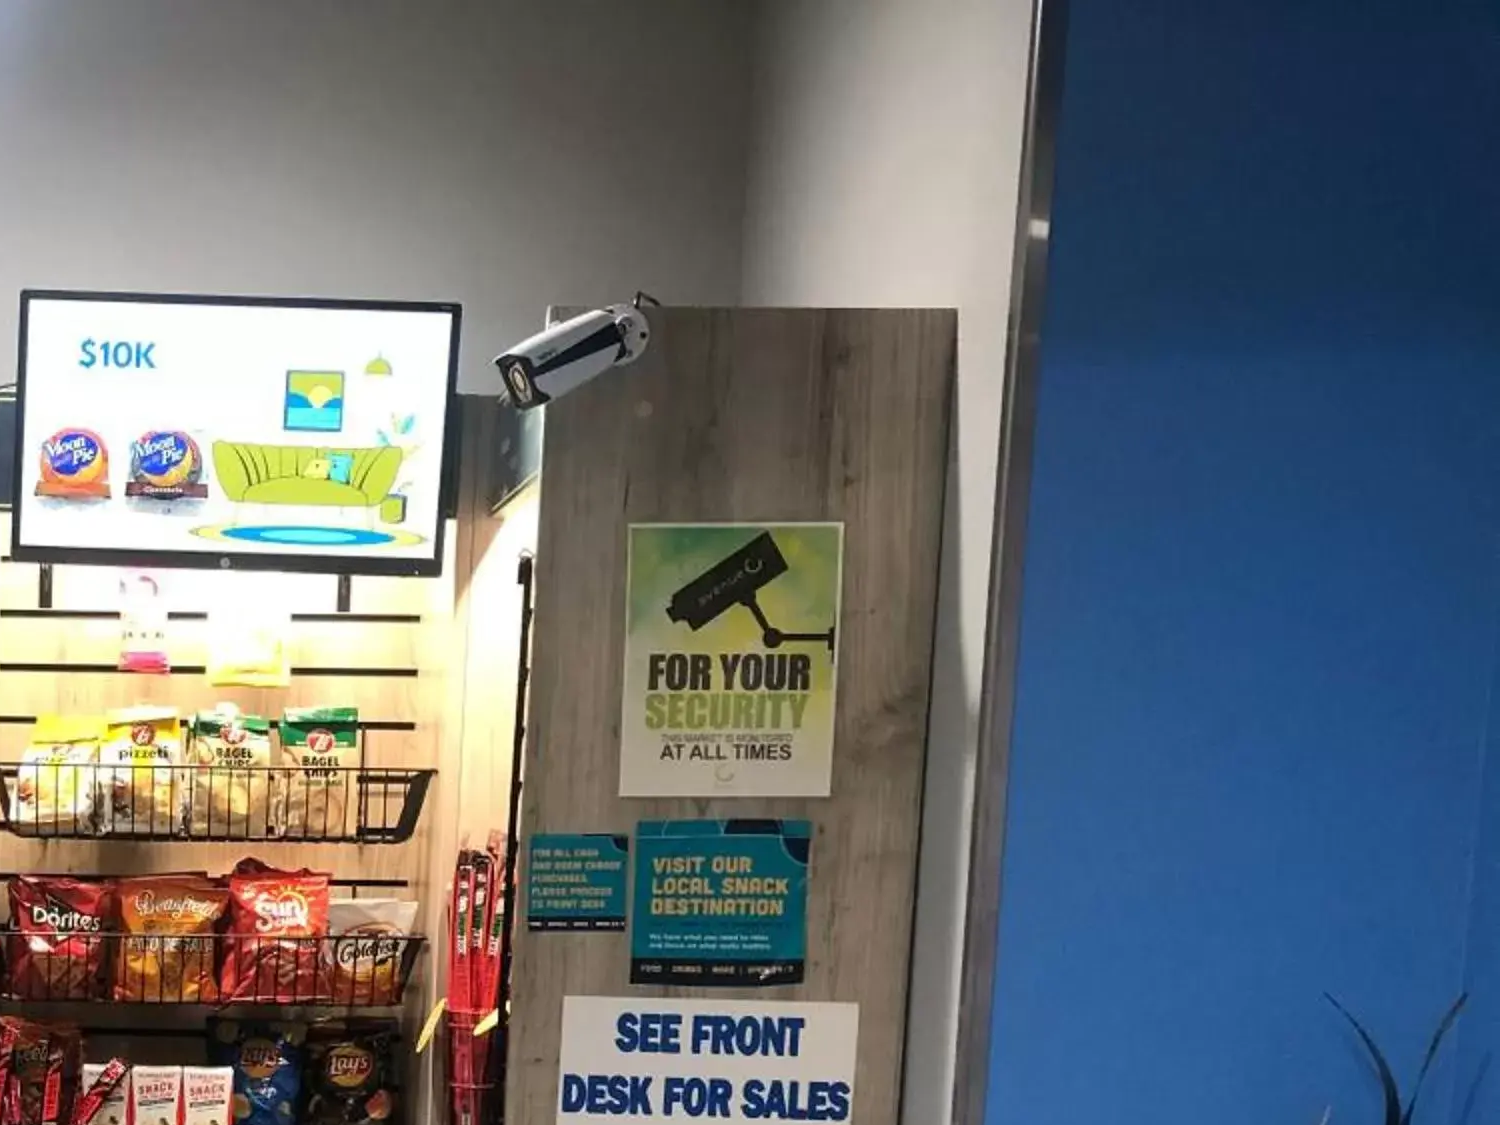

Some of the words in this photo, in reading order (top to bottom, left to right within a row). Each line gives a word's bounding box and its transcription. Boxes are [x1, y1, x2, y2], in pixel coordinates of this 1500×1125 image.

[78, 338, 155, 369] $10K
[45, 437, 86, 456] Moon
[73, 449, 95, 465] Pie
[648, 654, 711, 690] FOR
[720, 654, 810, 690] YOUR
[645, 693, 810, 730] SECURITY
[216, 748, 252, 759] BAGEL
[302, 756, 339, 767] BAGEL
[660, 744, 686, 760] AT
[689, 744, 727, 760] ALL
[733, 744, 792, 760] TIMES
[653, 856, 705, 873] VISIT
[712, 856, 753, 873] OUR
[652, 878, 714, 894] LOCAL
[722, 878, 788, 894] SNACK
[254, 892, 307, 932] Sun
[652, 899, 783, 916] DESTINATION
[615, 1012, 682, 1054] SEE
[691, 1014, 805, 1057] FRONT
[330, 1054, 368, 1075] Lay's
[562, 1073, 654, 1116] DESK
[663, 1077, 733, 1118] FOR
[741, 1080, 850, 1121] SALES
